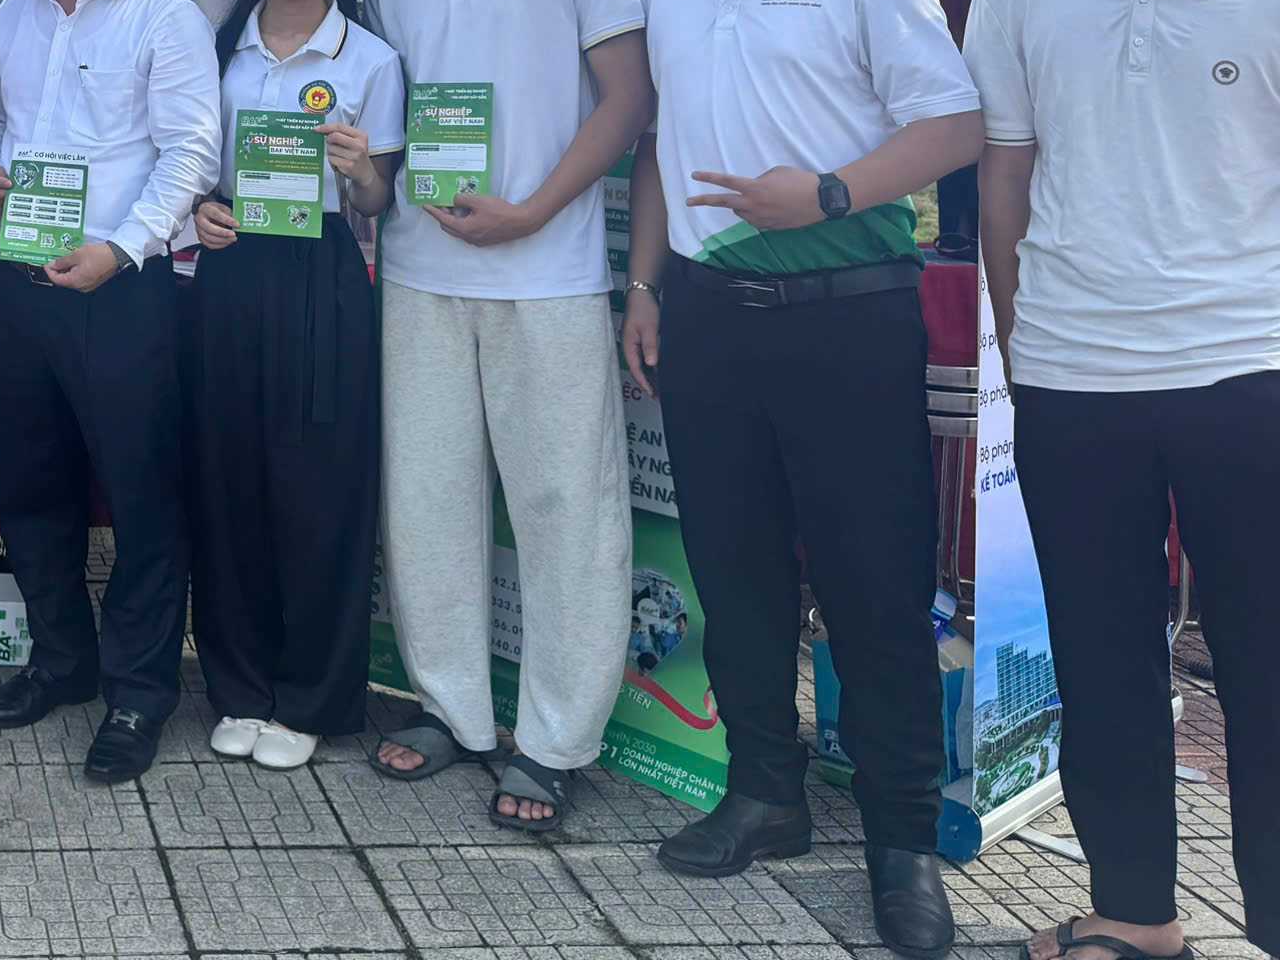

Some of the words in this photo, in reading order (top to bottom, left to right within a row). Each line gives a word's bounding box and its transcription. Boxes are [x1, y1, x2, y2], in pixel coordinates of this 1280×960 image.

[990, 383, 1008, 403] phậ
[980, 470, 991, 494] KẾ
[991, 464, 1017, 489] TOÁN
[609, 746, 618, 758] 1
[623, 747, 654, 766] DOANH
[654, 759, 688, 782] NGHIỆP
[638, 764, 663, 780] NHẤT
[664, 774, 685, 790] VIỆT
[684, 784, 707, 800] NAM
